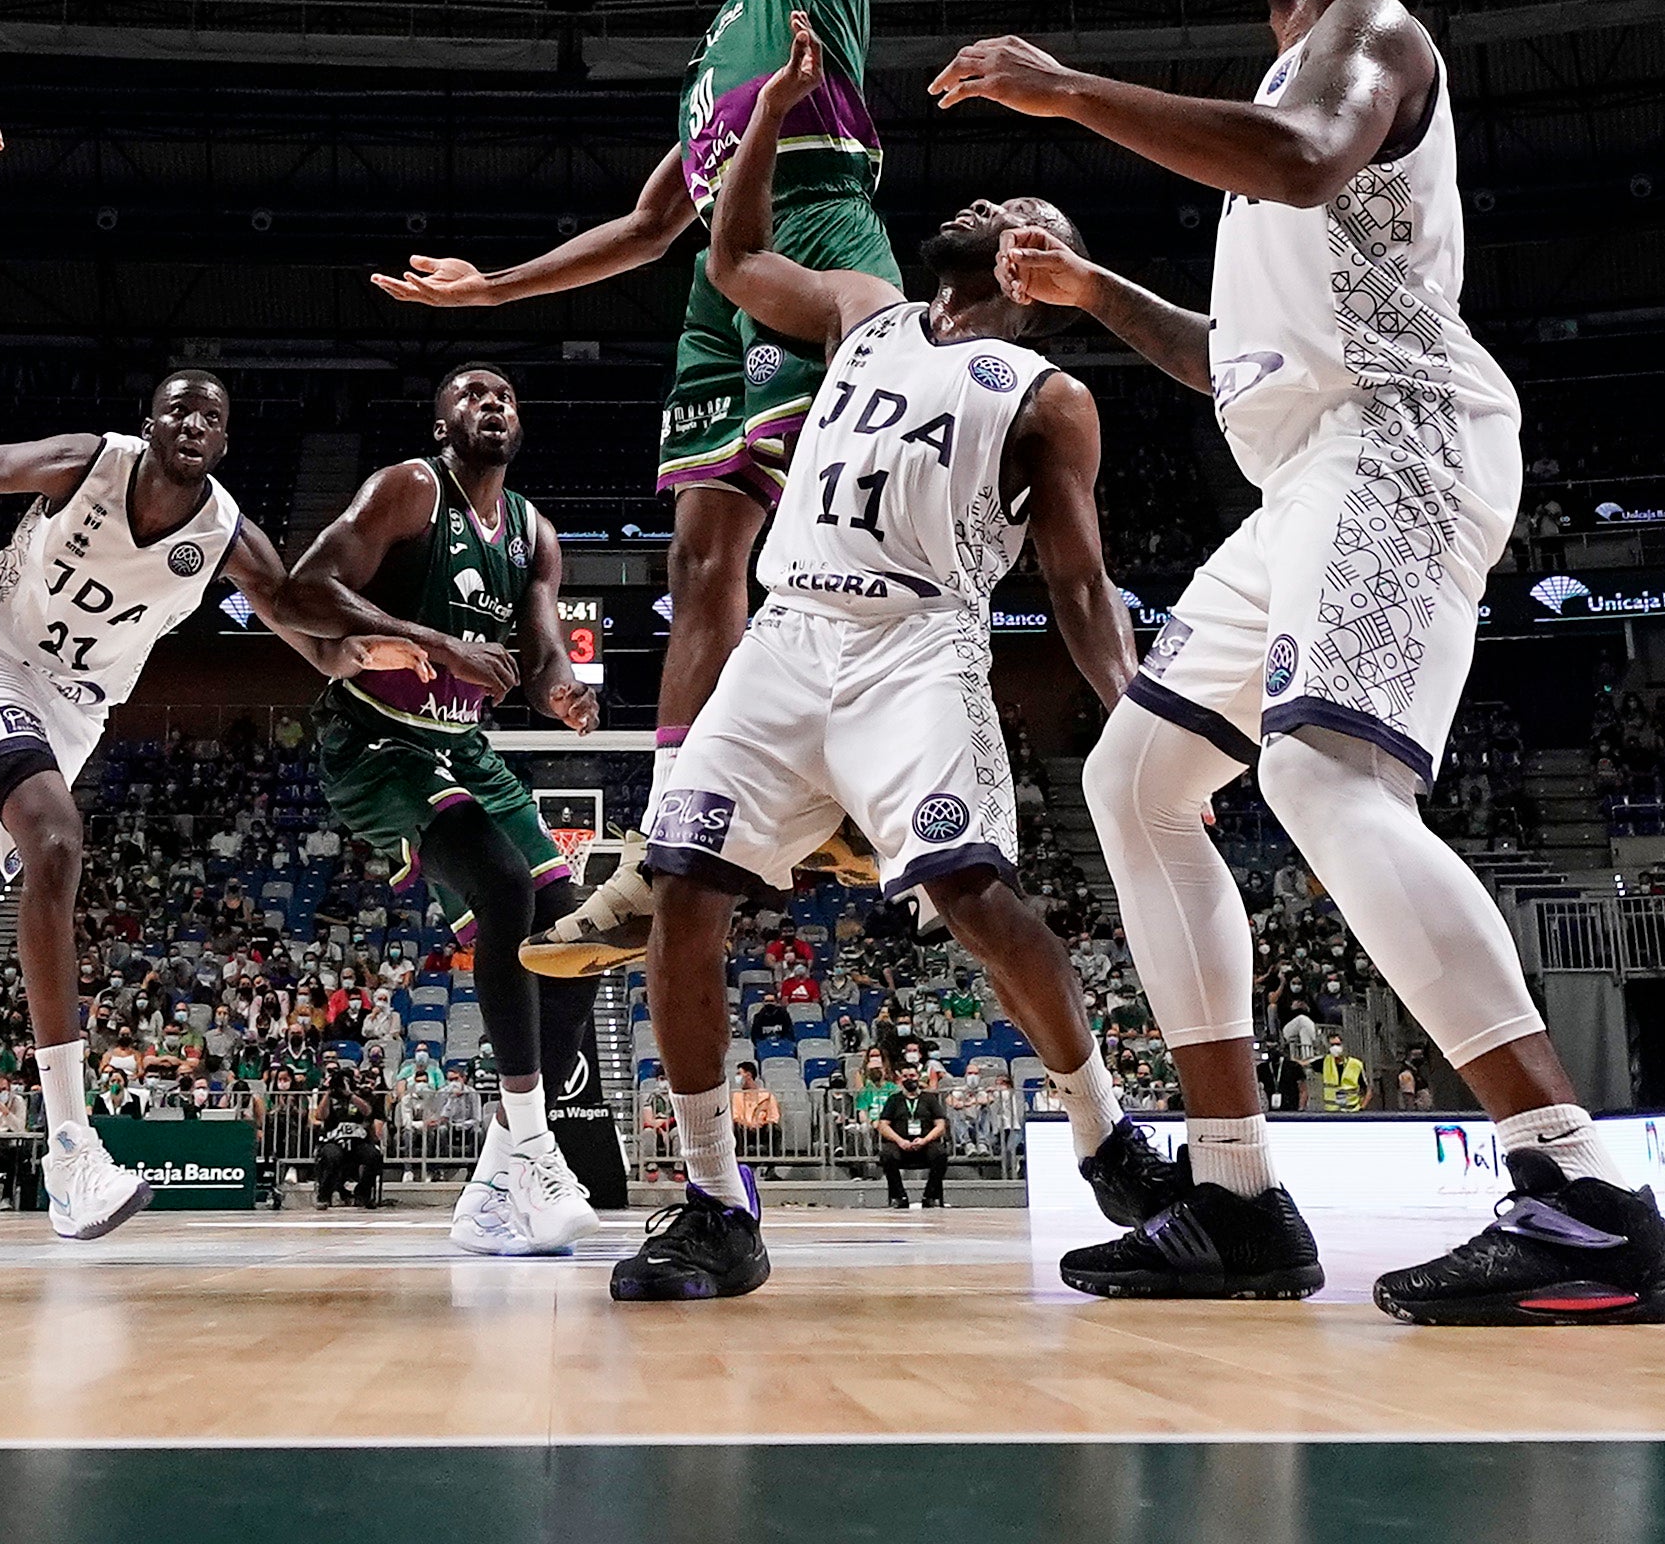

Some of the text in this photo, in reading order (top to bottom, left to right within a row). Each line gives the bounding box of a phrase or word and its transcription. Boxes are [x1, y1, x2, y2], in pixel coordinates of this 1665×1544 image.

[818, 381, 956, 468] JDA
[816, 462, 889, 542] 11
[45, 558, 148, 626] JDA
[1587, 592, 1661, 614] Unicaja
[992, 610, 1047, 628] Banco
[38, 621, 98, 671] 21
[569, 627, 595, 663] 3
[654, 795, 727, 838] Plus
[565, 1106, 609, 1120] Wagen
[125, 1162, 245, 1185] nicaja Banco
